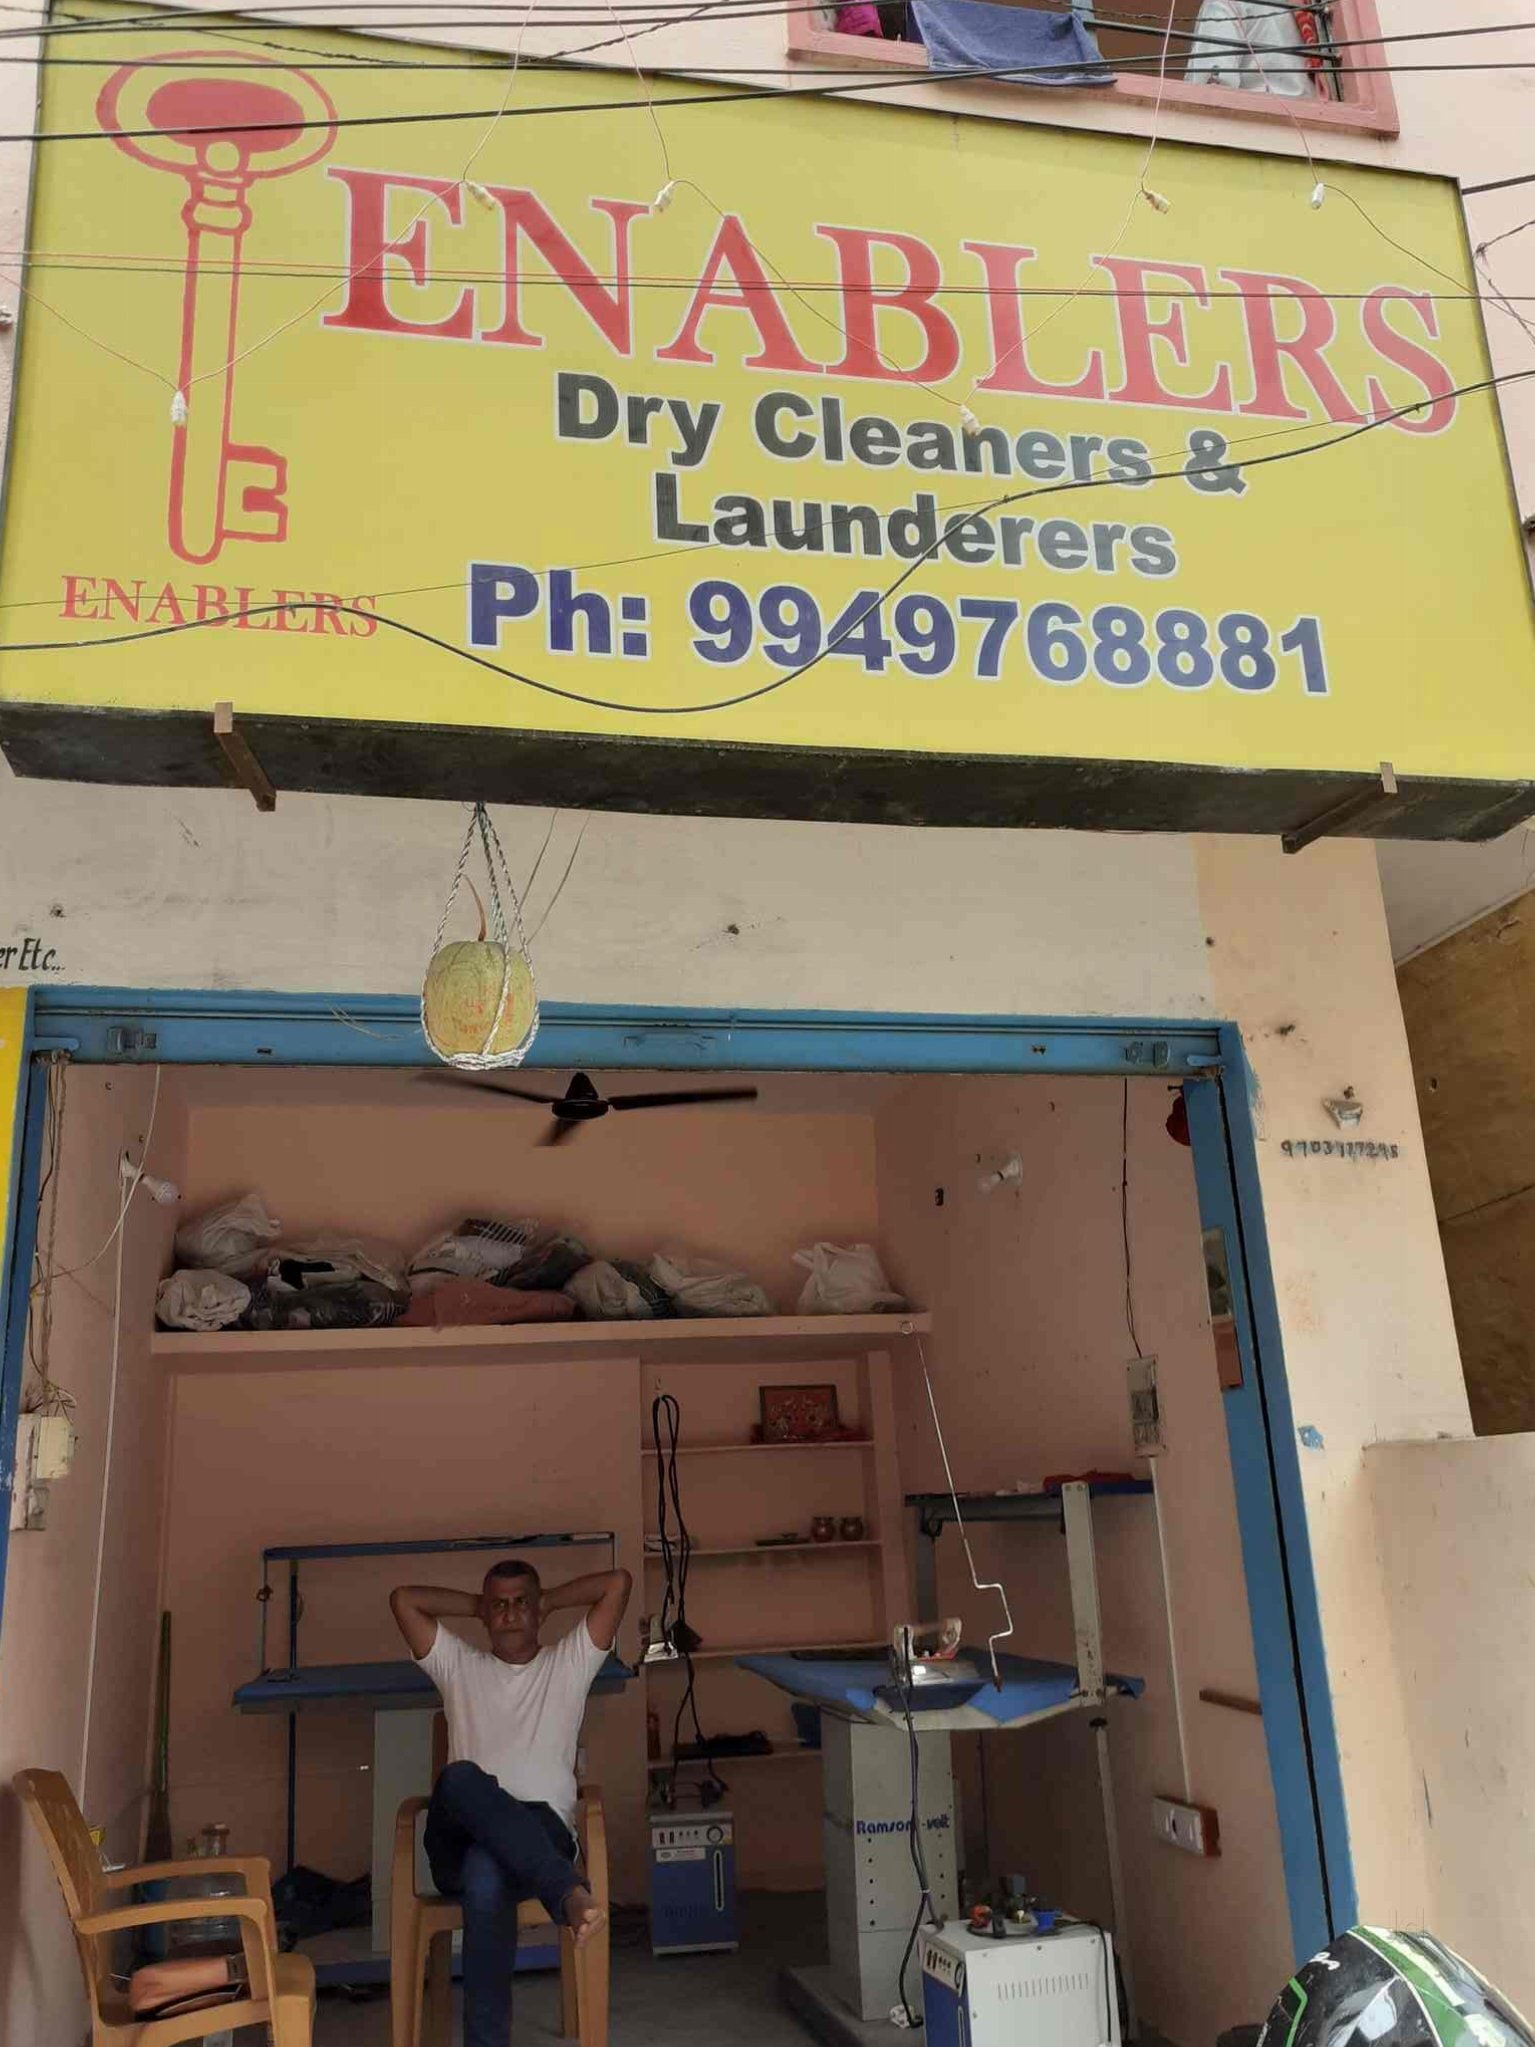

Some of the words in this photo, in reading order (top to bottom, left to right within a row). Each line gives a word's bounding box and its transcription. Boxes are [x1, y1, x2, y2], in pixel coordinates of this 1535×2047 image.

[322, 167, 1457, 433] ENABLERS
[558, 373, 722, 466] Dry
[756, 393, 1151, 487] Cleaners
[1183, 431, 1246, 494] &
[656, 474, 1178, 575] Launderers
[59, 575, 379, 637] ENABLERS
[469, 564, 649, 656] Ph:
[691, 581, 1329, 693] 9949768881
